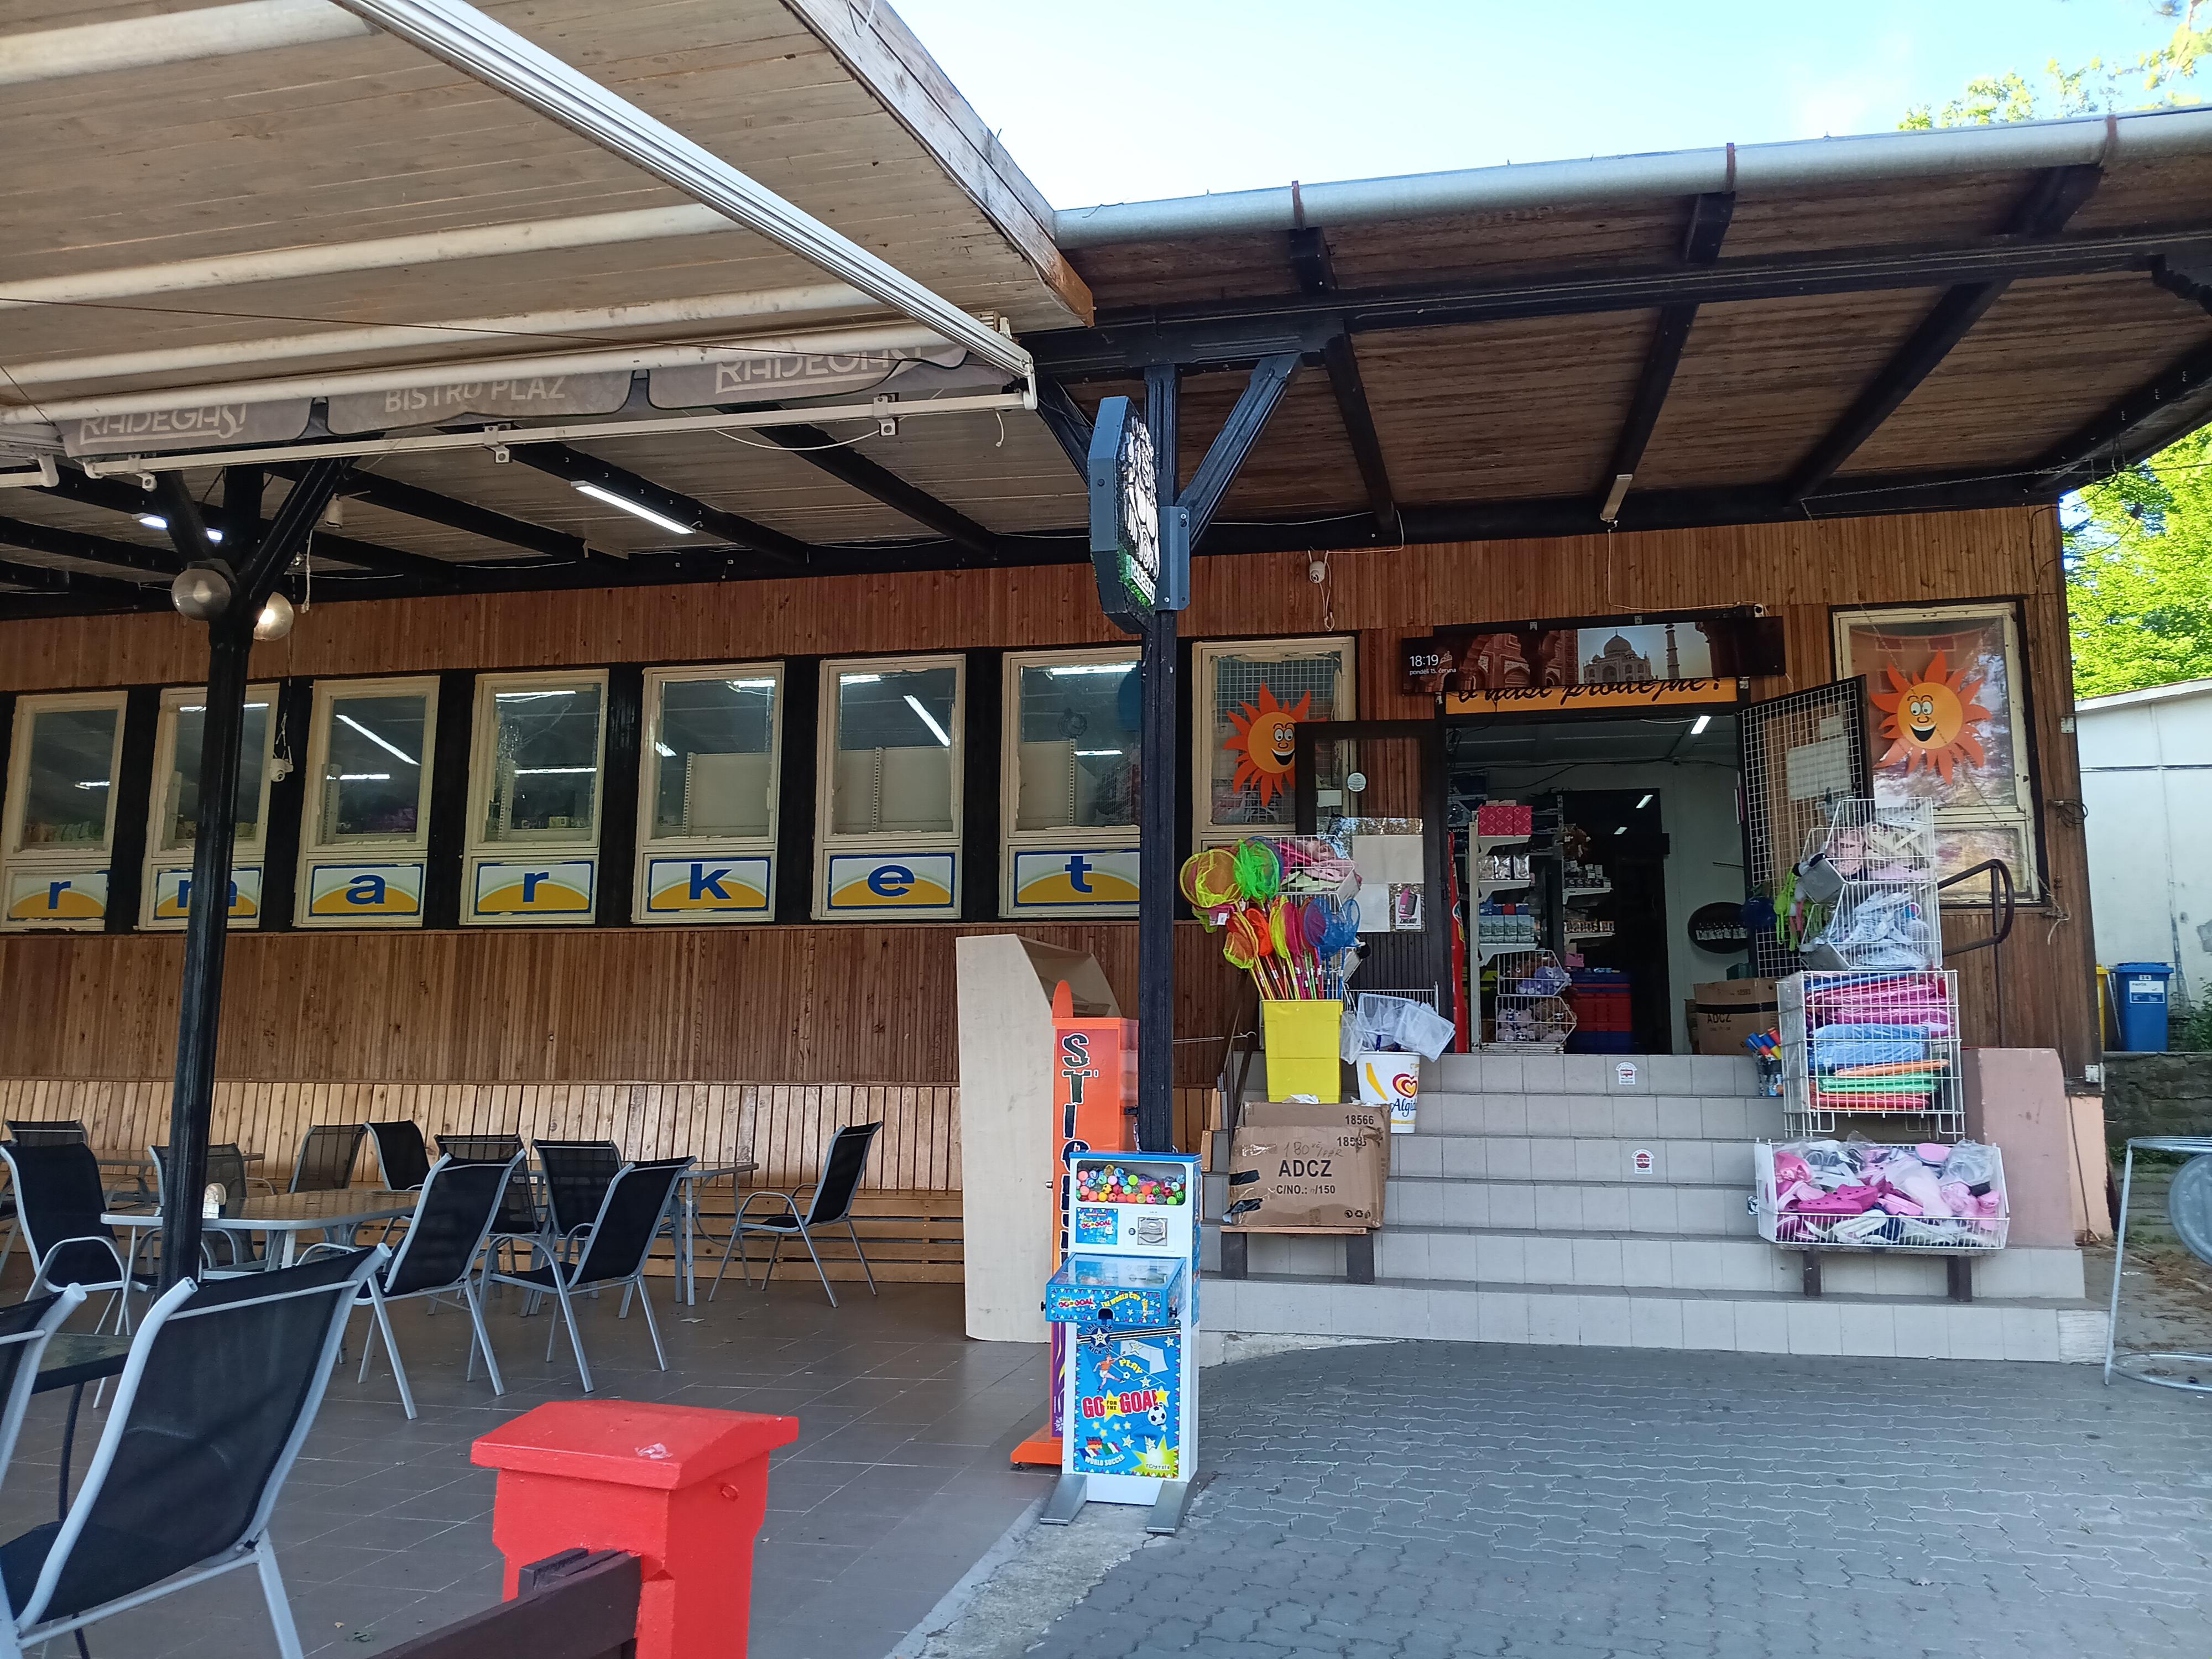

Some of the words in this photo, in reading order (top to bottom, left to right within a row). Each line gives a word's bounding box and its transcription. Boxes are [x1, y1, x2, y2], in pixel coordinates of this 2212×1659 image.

[1409, 654, 1439, 667] 18:19
[1344, 1114, 1374, 1125] 18566
[1278, 1160, 1332, 1177] ADCZ
[1276, 1185, 1307, 1194] C/NO.:
[1119, 1359, 1143, 1374] PLAY
[1082, 1396, 1105, 1418] GO
[1085, 1455, 1104, 1466] WORLD
[1104, 1454, 1126, 1466] SOCCER
